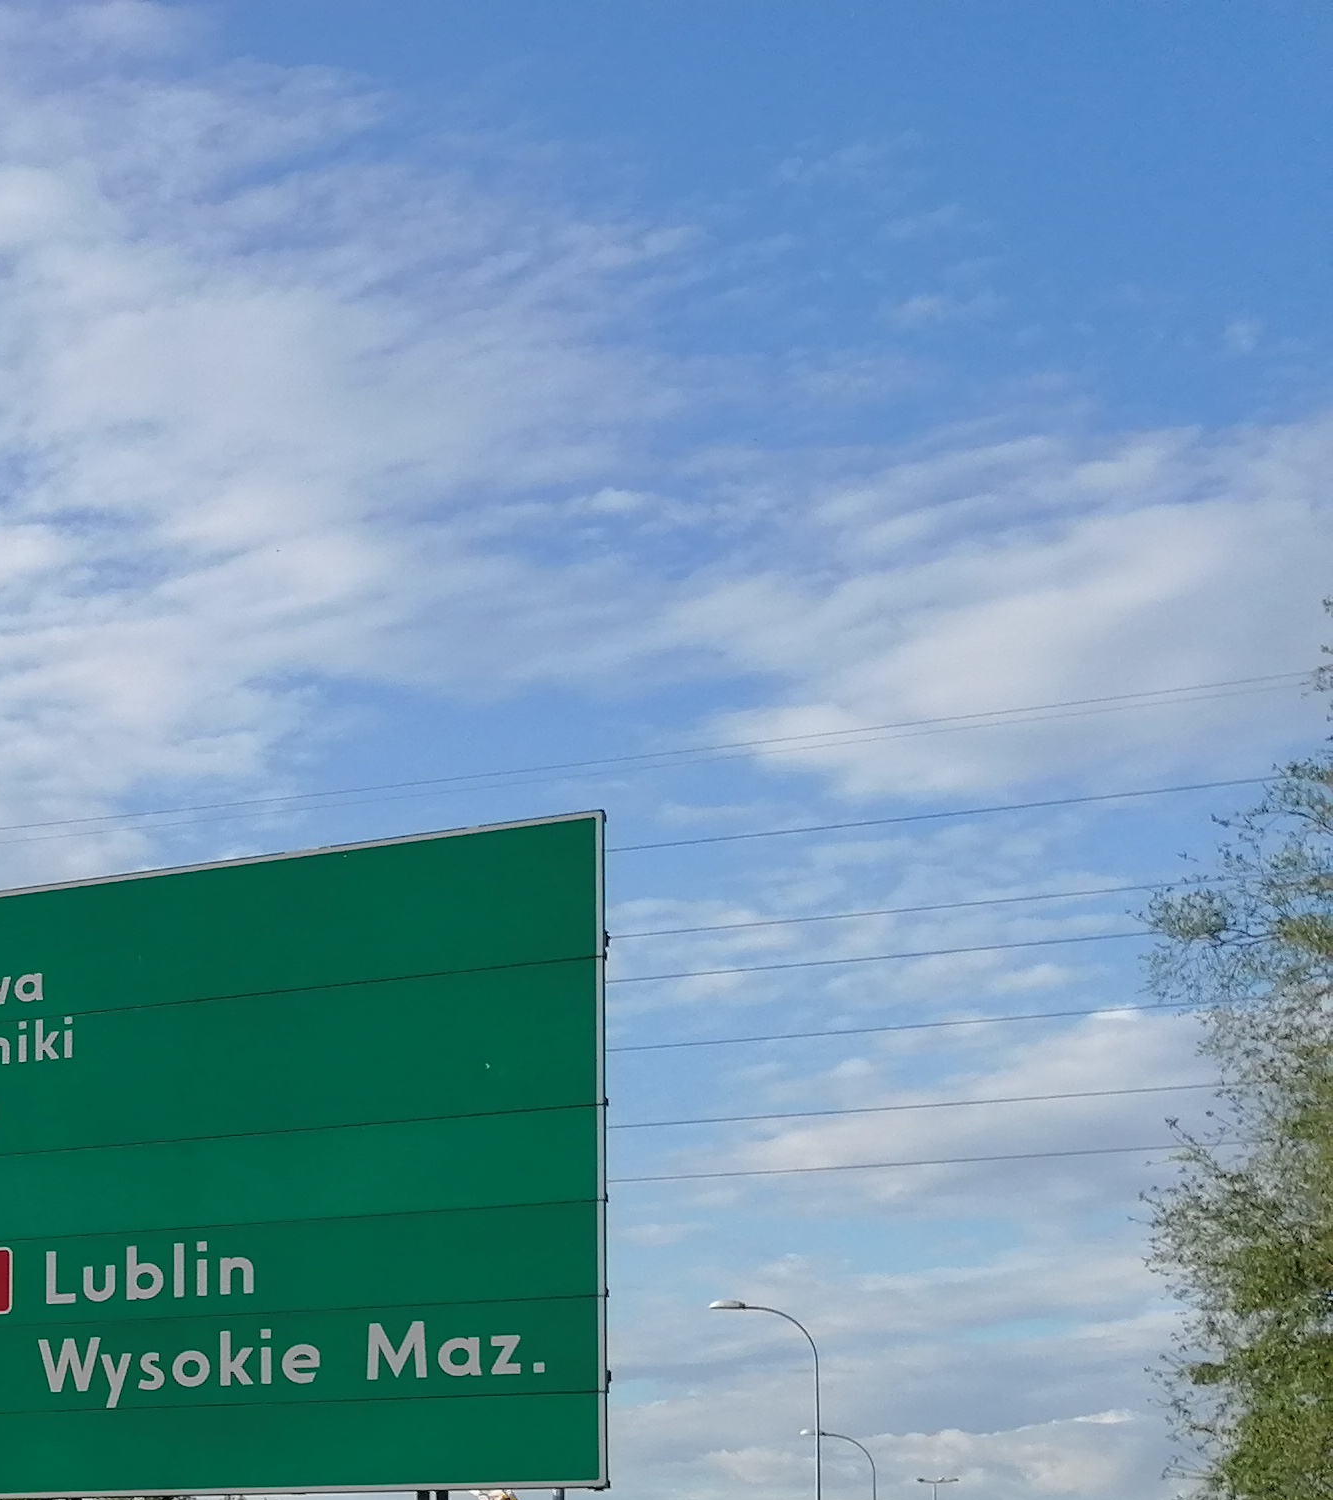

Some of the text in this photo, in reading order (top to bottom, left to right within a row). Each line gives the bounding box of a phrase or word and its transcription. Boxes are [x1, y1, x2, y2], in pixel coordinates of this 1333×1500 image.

[45, 1241, 255, 1304] Lublin
[38, 1321, 546, 1408] Wysokie Maz.
